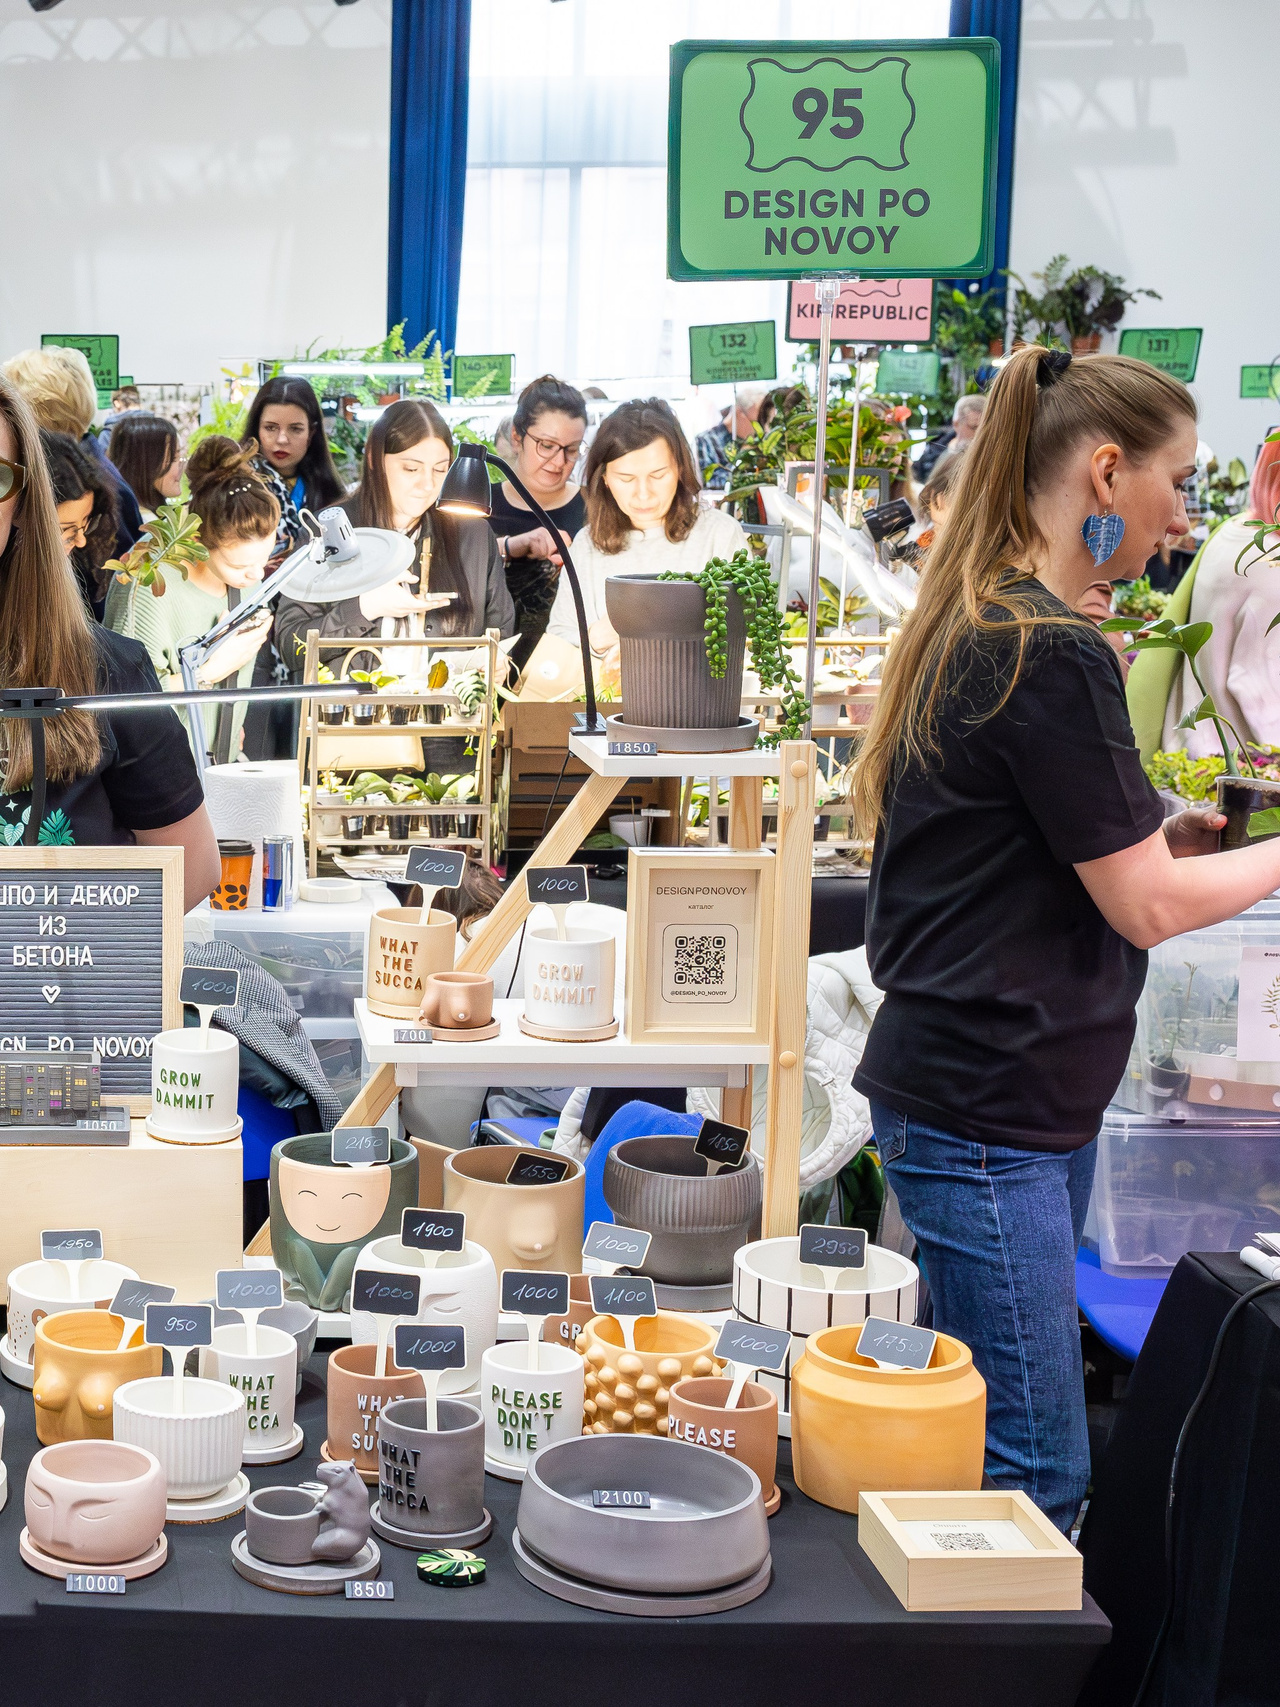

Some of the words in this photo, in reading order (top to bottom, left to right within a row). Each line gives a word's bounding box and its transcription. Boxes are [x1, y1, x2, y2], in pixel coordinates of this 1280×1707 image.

[792, 86, 865, 140] 95
[724, 188, 865, 219] DESIGN
[878, 187, 930, 218] PO
[764, 225, 900, 256] NOVOY
[720, 333, 746, 348] 132
[615, 742, 651, 754] 1850
[414, 857, 455, 874] 1000
[537, 877, 579, 892] 1000
[43, 884, 59, 906] И
[70, 884, 141, 906] ДЕКОР
[38, 914, 68, 936] ИЗ
[379, 936, 420, 956] WHAT
[12, 945, 95, 967] БЕТОНА
[382, 954, 413, 972] THE
[375, 969, 423, 991] SUCCA
[538, 961, 585, 983] GROW
[191, 977, 236, 995] 1000
[531, 982, 597, 1006] DAMMIT
[401, 1030, 427, 1042] 700
[160, 1067, 202, 1088] GROW
[155, 1087, 215, 1110] DAMMIT
[82, 1119, 117, 1131] 1050
[344, 1135, 385, 1150] 2150
[520, 1164, 558, 1180] 1550
[412, 1221, 454, 1239] 1900
[594, 1234, 640, 1254] 1000
[228, 1282, 280, 1299] 1000
[363, 1282, 415, 1301] 1000
[511, 1282, 559, 1300] 1000
[602, 1287, 648, 1306] 1100
[163, 1316, 198, 1333] 950
[406, 1337, 458, 1356] 1000
[730, 1335, 780, 1354] 1000
[229, 1373, 276, 1391] WHAT
[491, 1383, 564, 1409] PLEASE
[502, 1430, 539, 1451] DIE
[667, 1414, 737, 1450] PLEASE
[380, 1438, 422, 1468] WHAT
[384, 1462, 417, 1489] THE
[379, 1481, 431, 1514] SUCCA
[600, 1490, 643, 1505] 2100
[74, 1575, 119, 1592] 1000
[353, 1581, 387, 1598] 850
